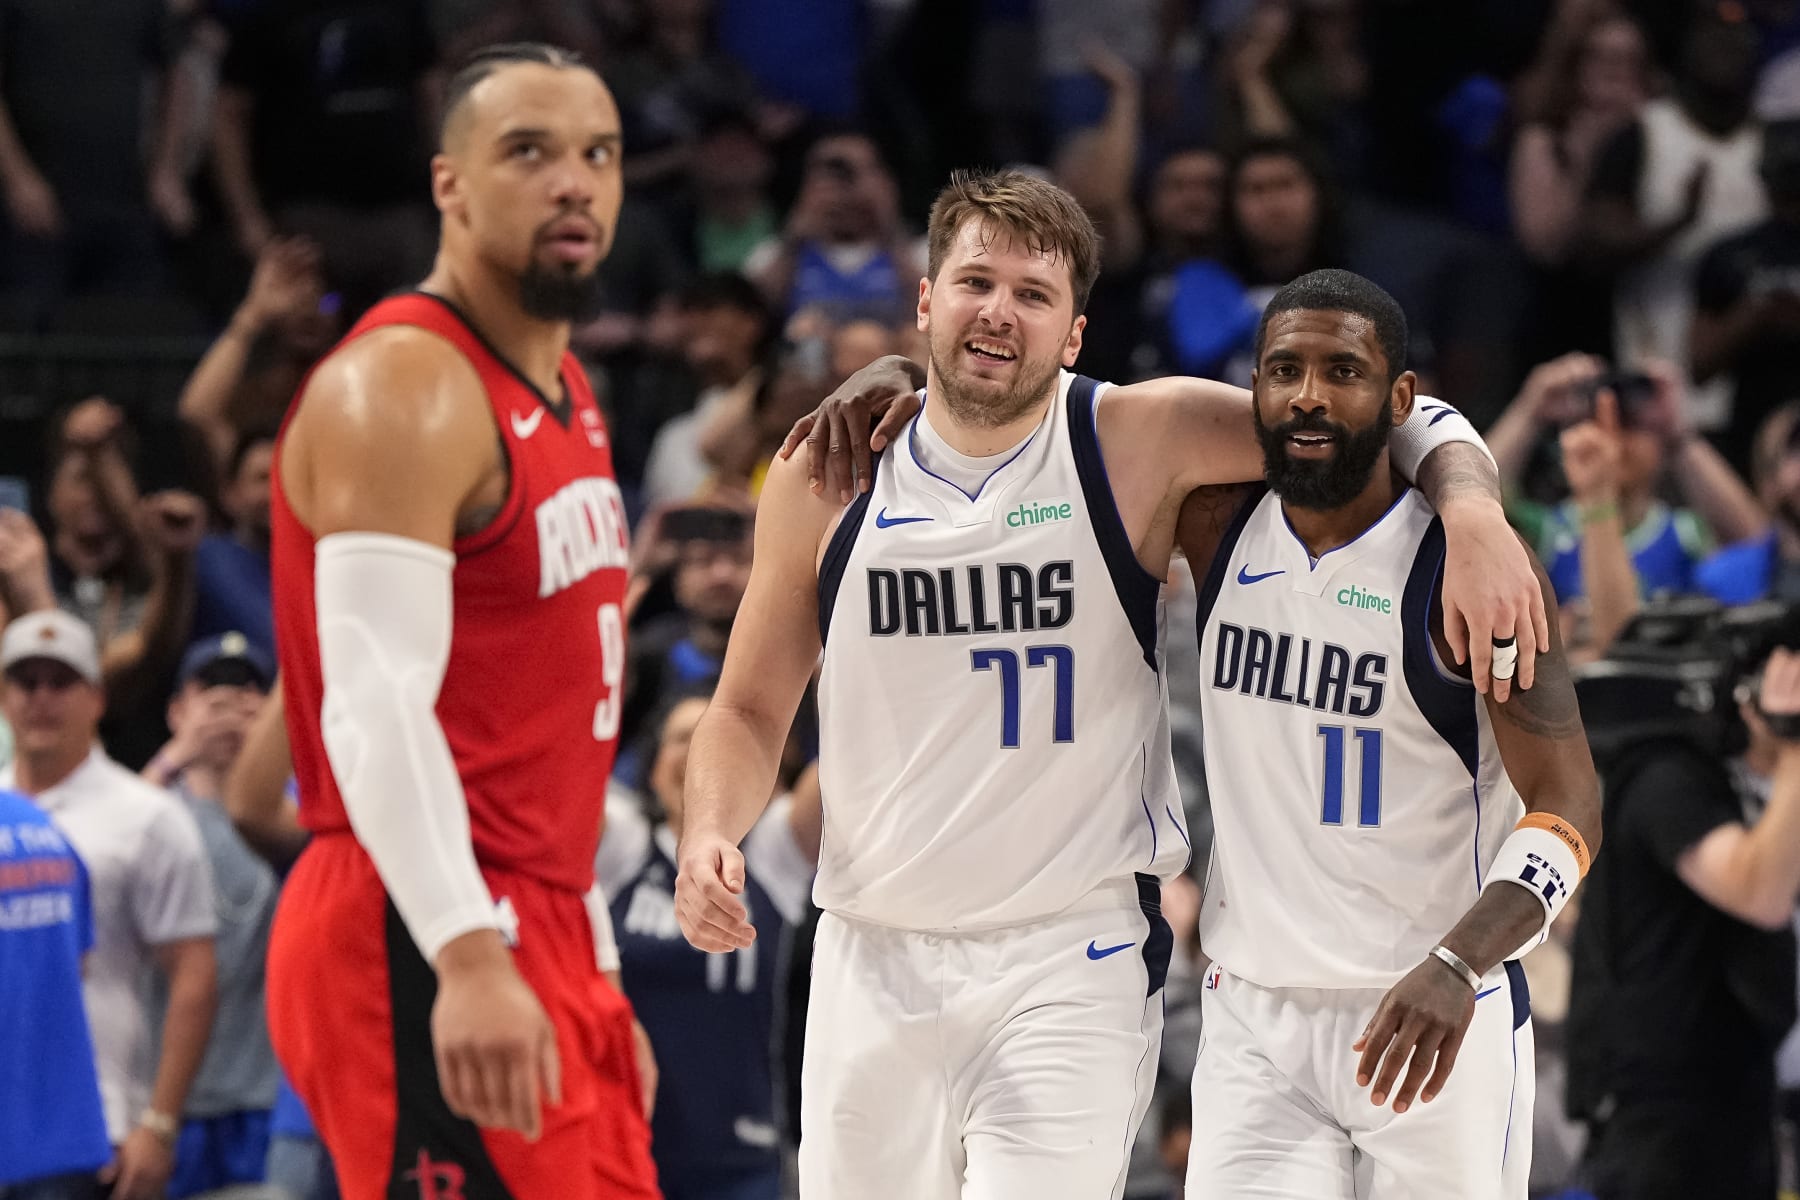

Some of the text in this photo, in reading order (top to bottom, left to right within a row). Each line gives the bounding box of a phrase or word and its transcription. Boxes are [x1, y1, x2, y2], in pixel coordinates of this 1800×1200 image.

[1006, 502, 1072, 528] chime
[866, 560, 1075, 637] DALLAS
[1337, 585, 1391, 615] chime
[592, 603, 625, 741] 9
[970, 644, 1075, 749] 77
[1212, 620, 1389, 719] DALLAS
[1316, 723, 1383, 828] 11
